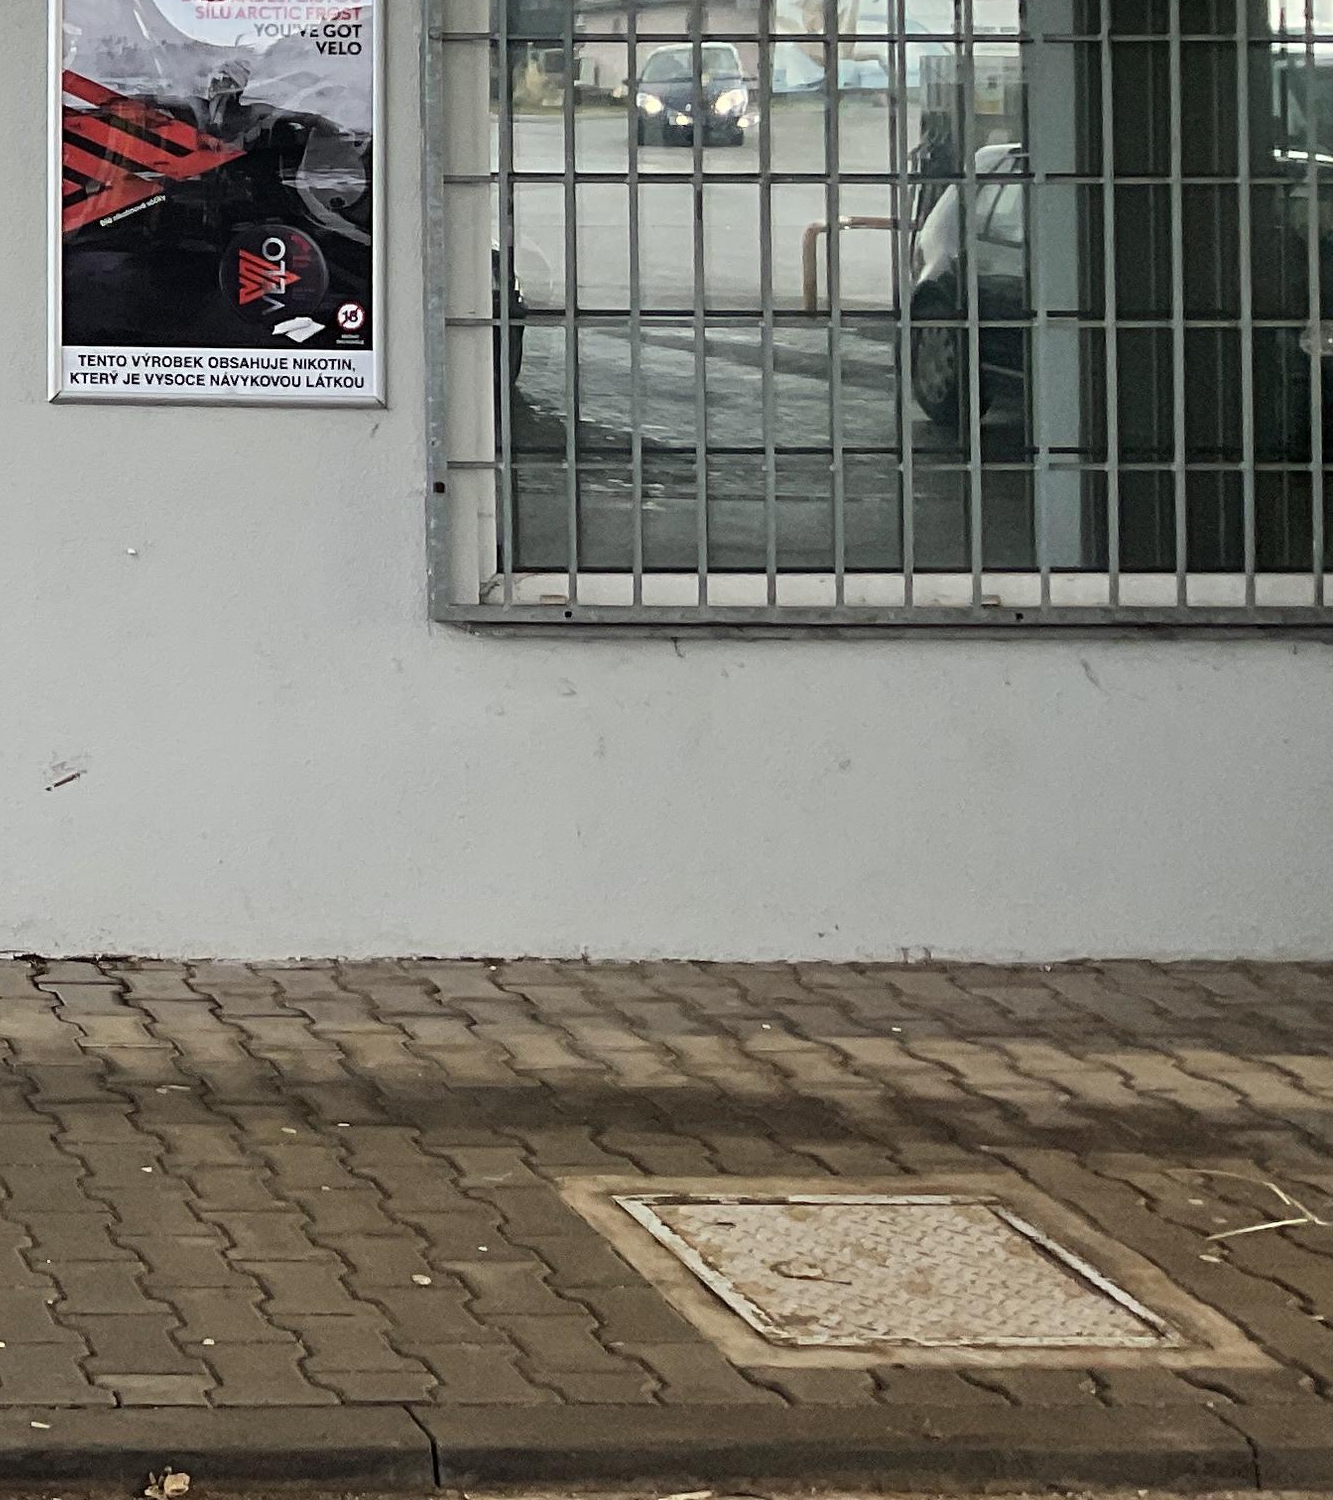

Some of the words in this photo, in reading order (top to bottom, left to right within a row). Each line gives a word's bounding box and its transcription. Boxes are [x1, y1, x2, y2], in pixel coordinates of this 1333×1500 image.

[234, 6, 301, 21] ARCTIC
[305, 6, 363, 21] FROST
[323, 23, 363, 39] GOT
[315, 40, 363, 56] VELO
[78, 354, 127, 368] TENTO
[131, 352, 204, 368] VÝROBEK
[207, 355, 289, 370] OBSAHUJE
[292, 357, 356, 372] NIKOTIN,
[69, 370, 119, 385] KTERÝ
[122, 372, 141, 386] JE
[144, 372, 206, 387] VYSOCE
[209, 371, 302, 388] NÁVYKOVOU
[305, 372, 365, 389] LÁTKOU
